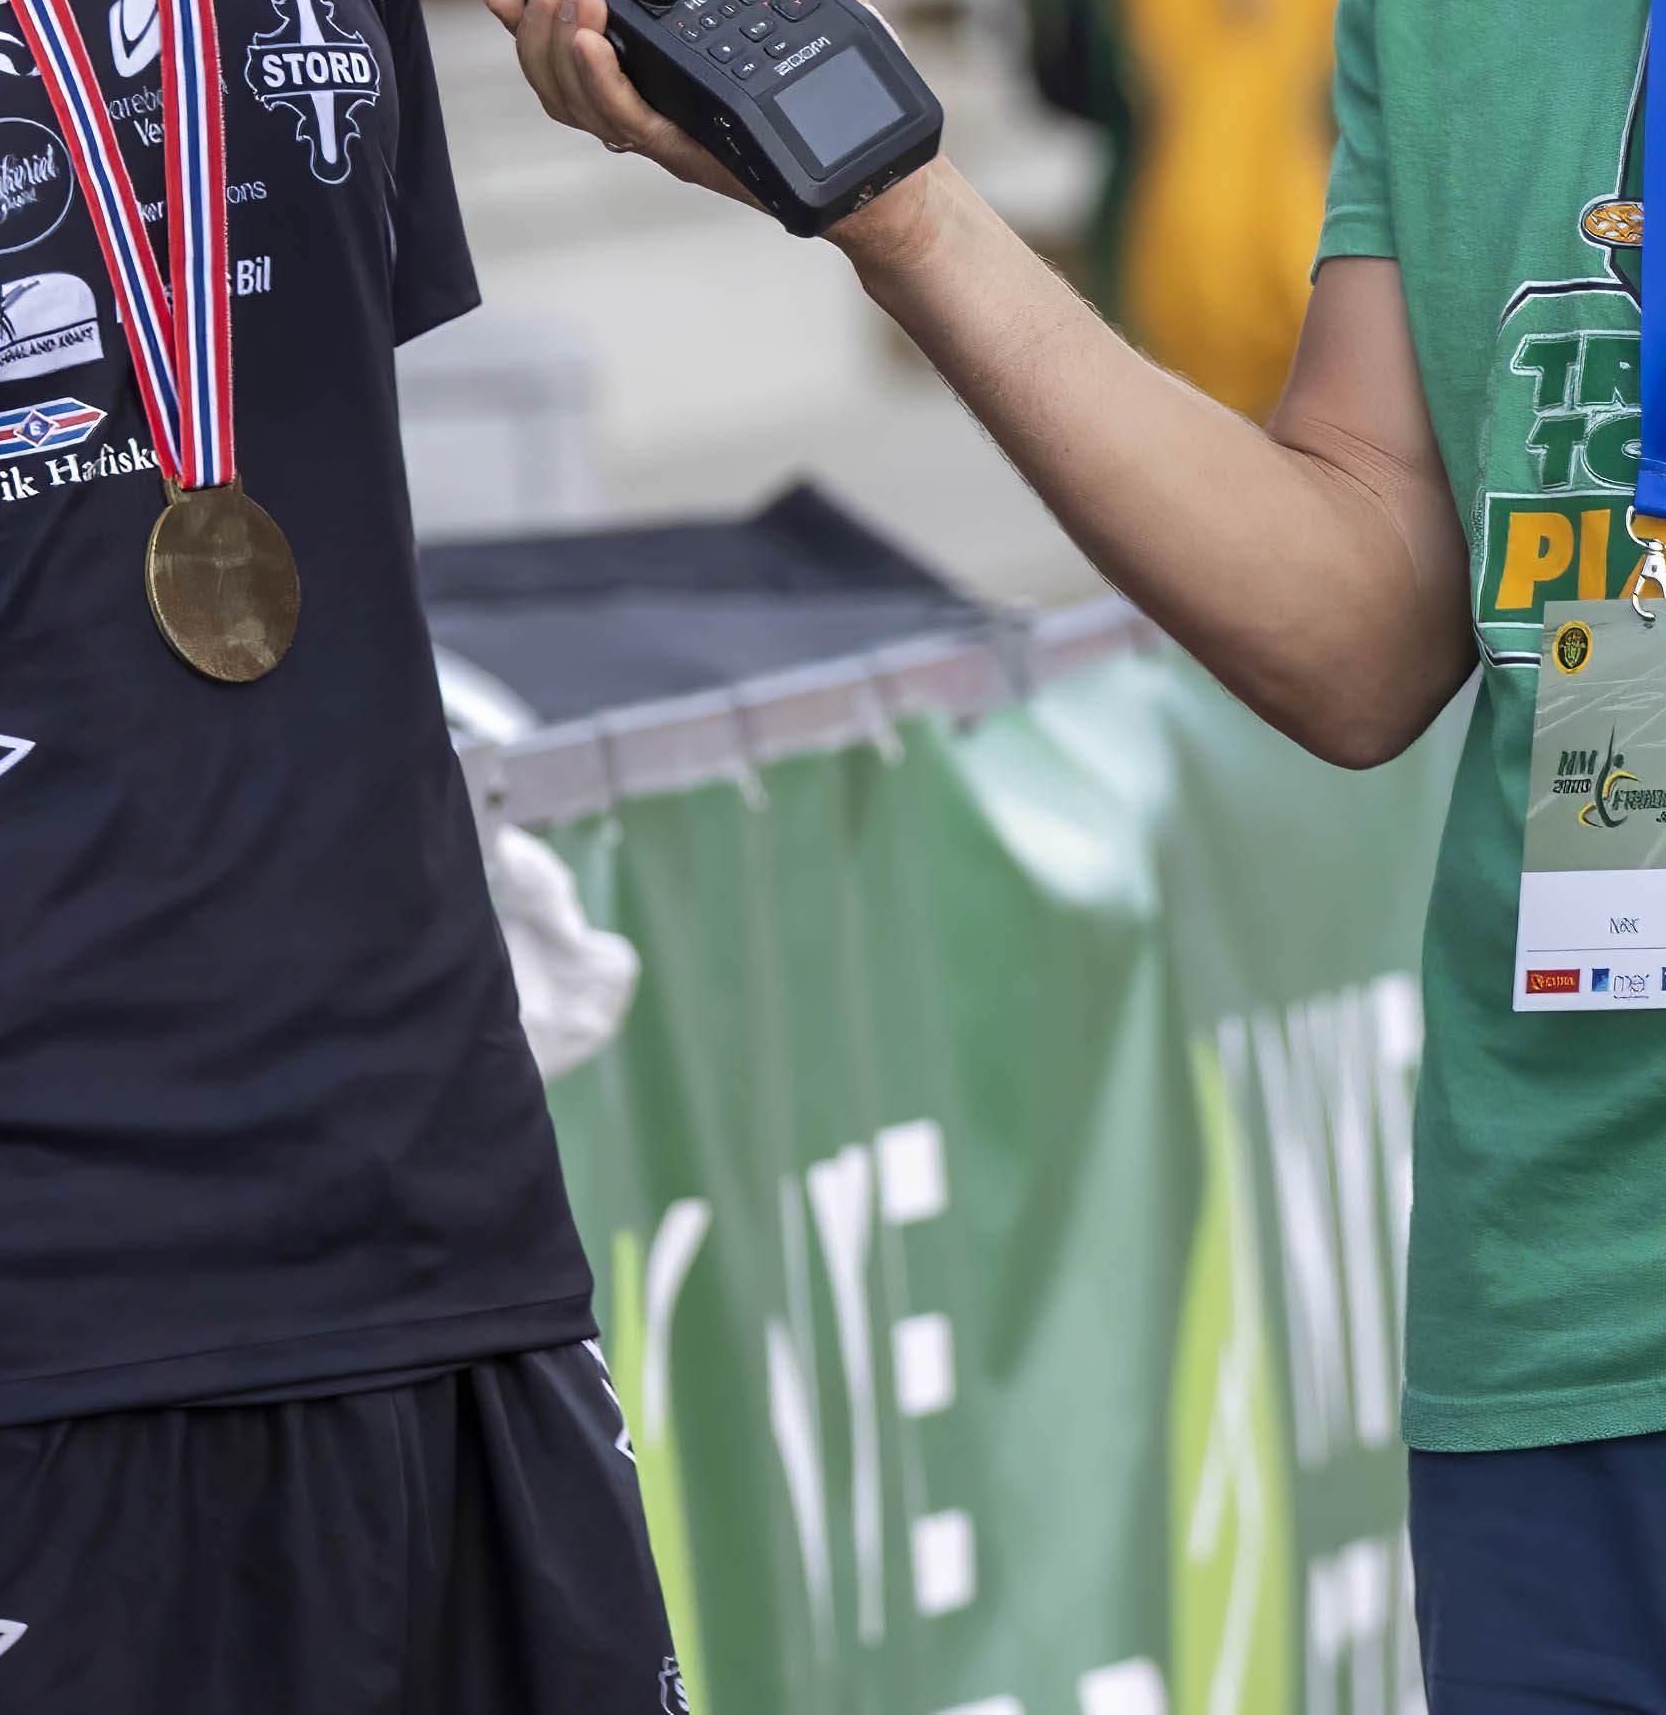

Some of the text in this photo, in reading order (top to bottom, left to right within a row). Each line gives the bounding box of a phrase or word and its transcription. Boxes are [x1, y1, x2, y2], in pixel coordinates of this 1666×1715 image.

[262, 51, 371, 88] STORD
[226, 181, 268, 204] ons
[236, 255, 271, 297] Bil
